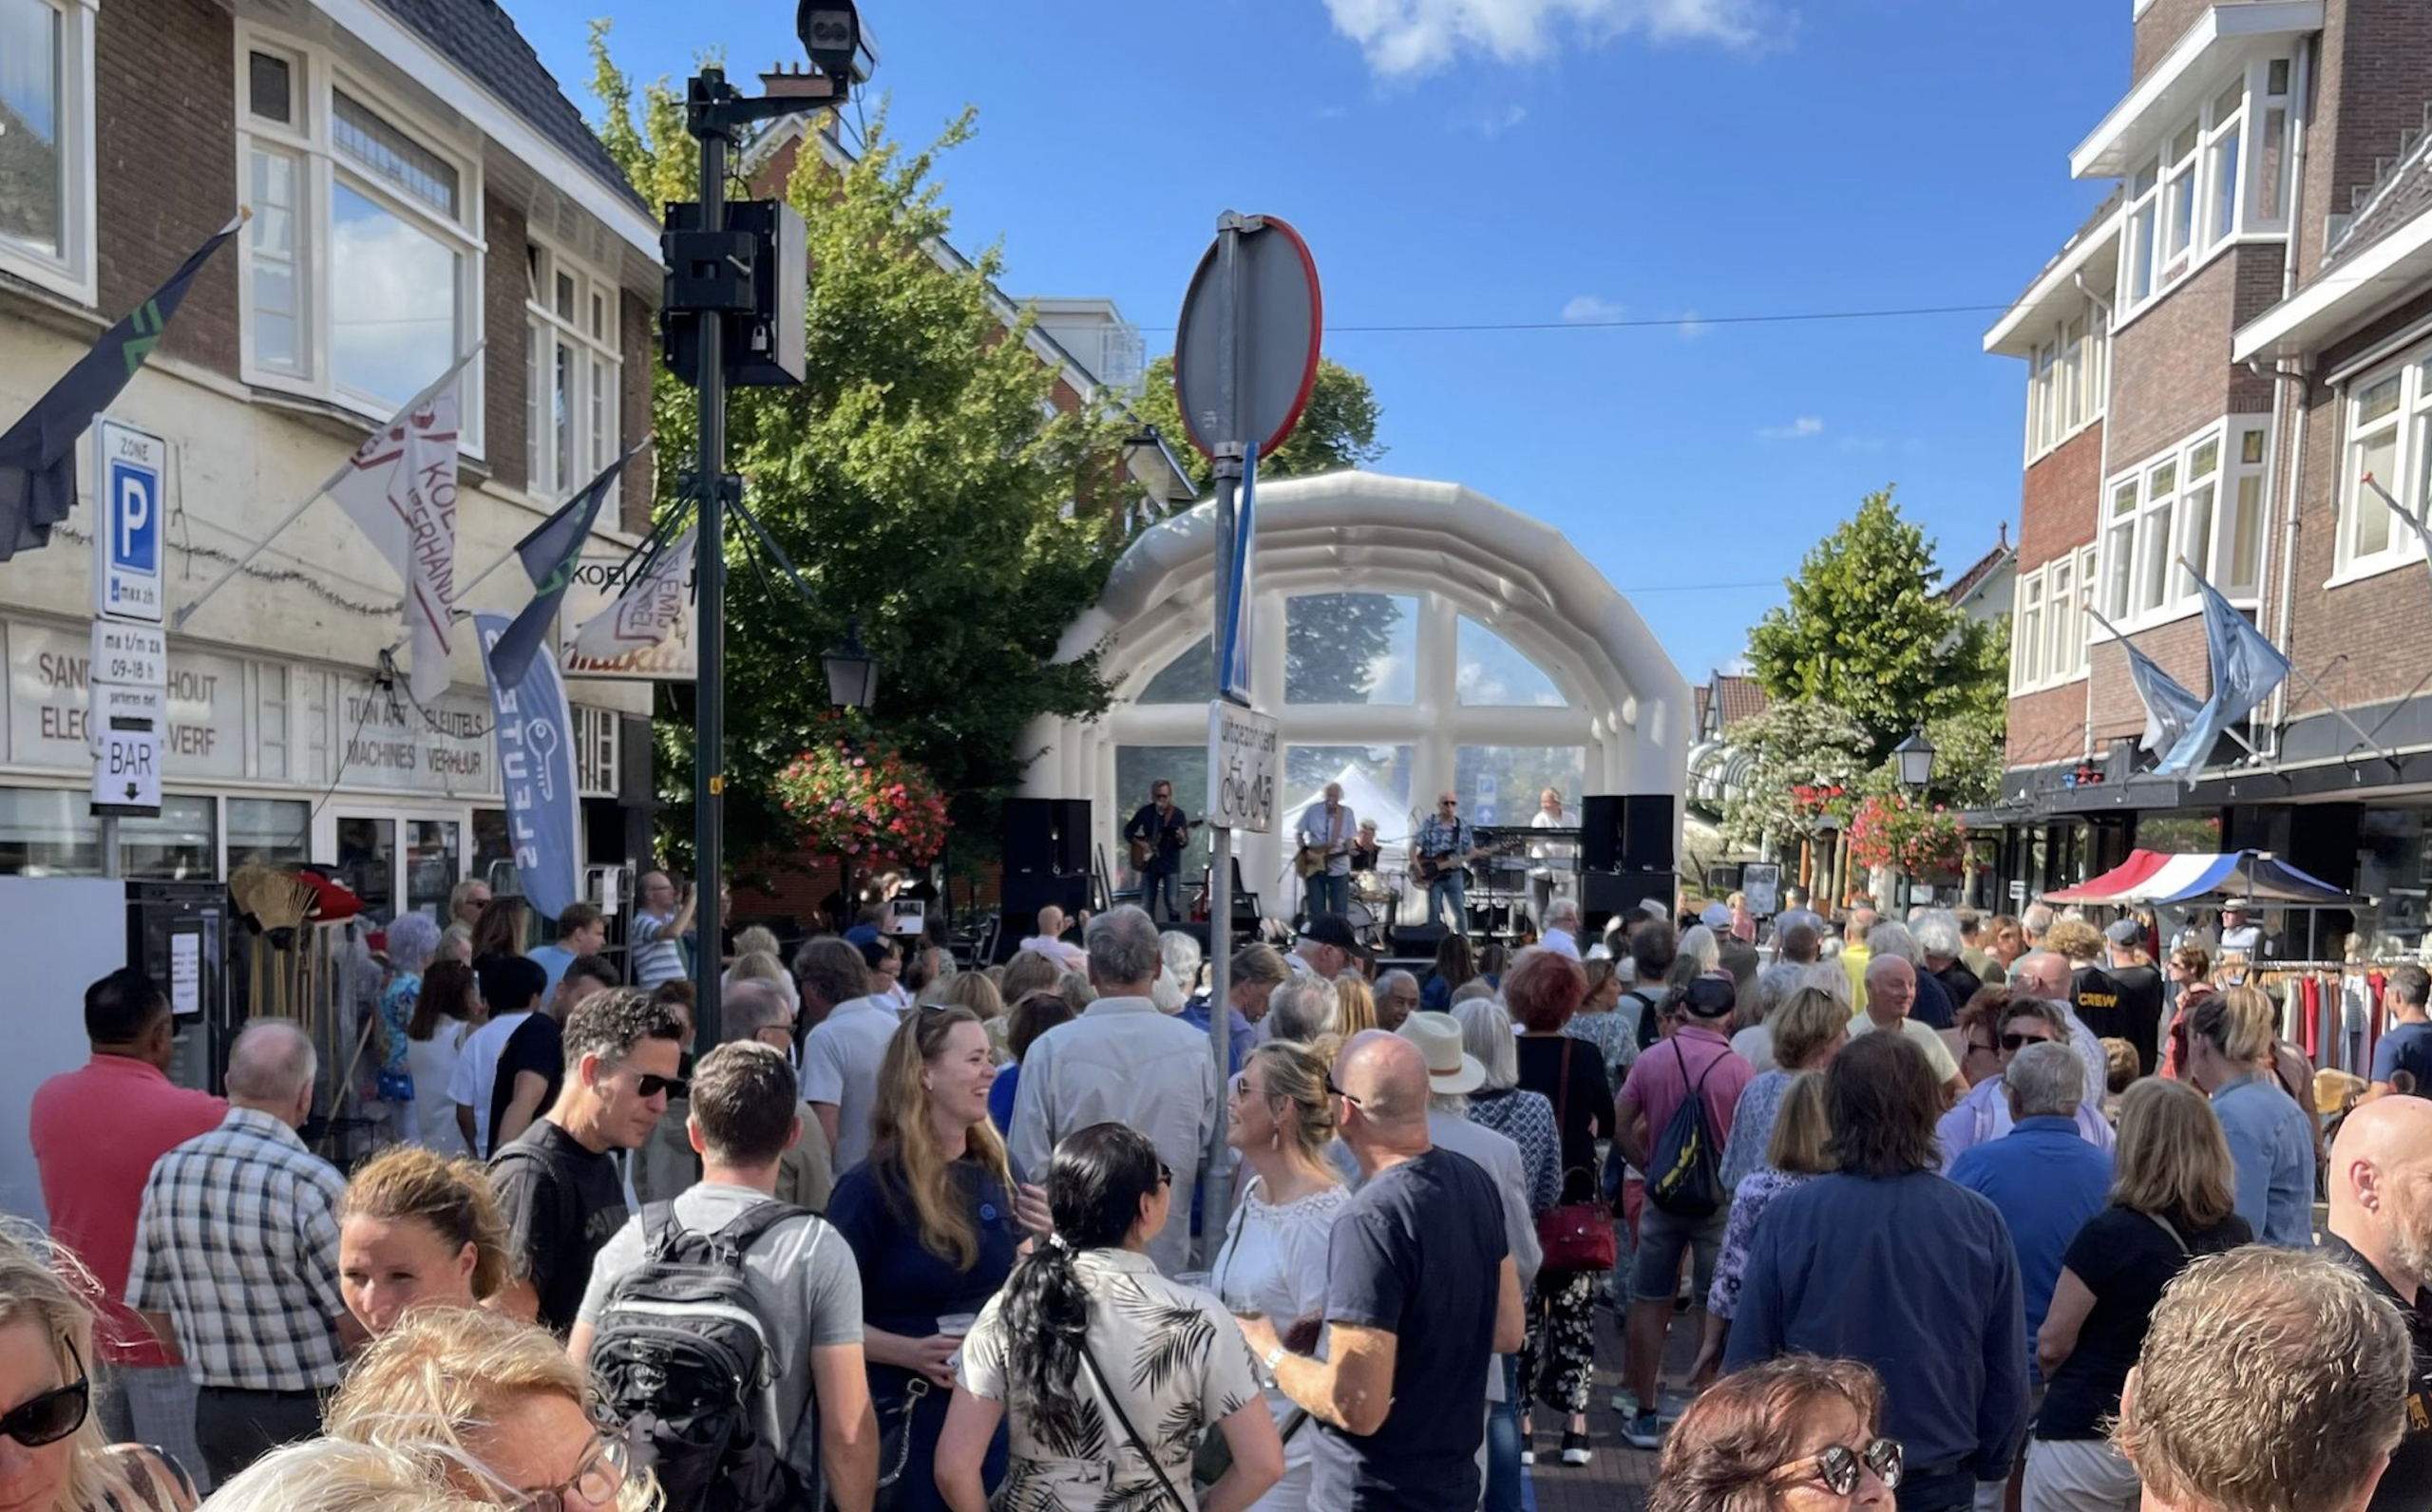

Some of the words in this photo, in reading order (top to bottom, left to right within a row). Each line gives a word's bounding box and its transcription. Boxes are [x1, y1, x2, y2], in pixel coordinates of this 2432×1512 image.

[121, 436, 148, 462] ZONE
[122, 475, 148, 558] P
[104, 633, 122, 649] ma
[124, 632, 145, 652] t/m
[148, 639, 162, 654] za
[110, 658, 143, 680] 09-18
[167, 668, 218, 706] HOUT
[347, 696, 379, 725] TUIN
[424, 709, 484, 738] SLEUTELS
[168, 723, 216, 758] VERF
[110, 743, 152, 775] BAR
[346, 740, 416, 771] MACHINES
[427, 747, 482, 775] VERHUUR
[2078, 992, 2118, 1008] CREW
